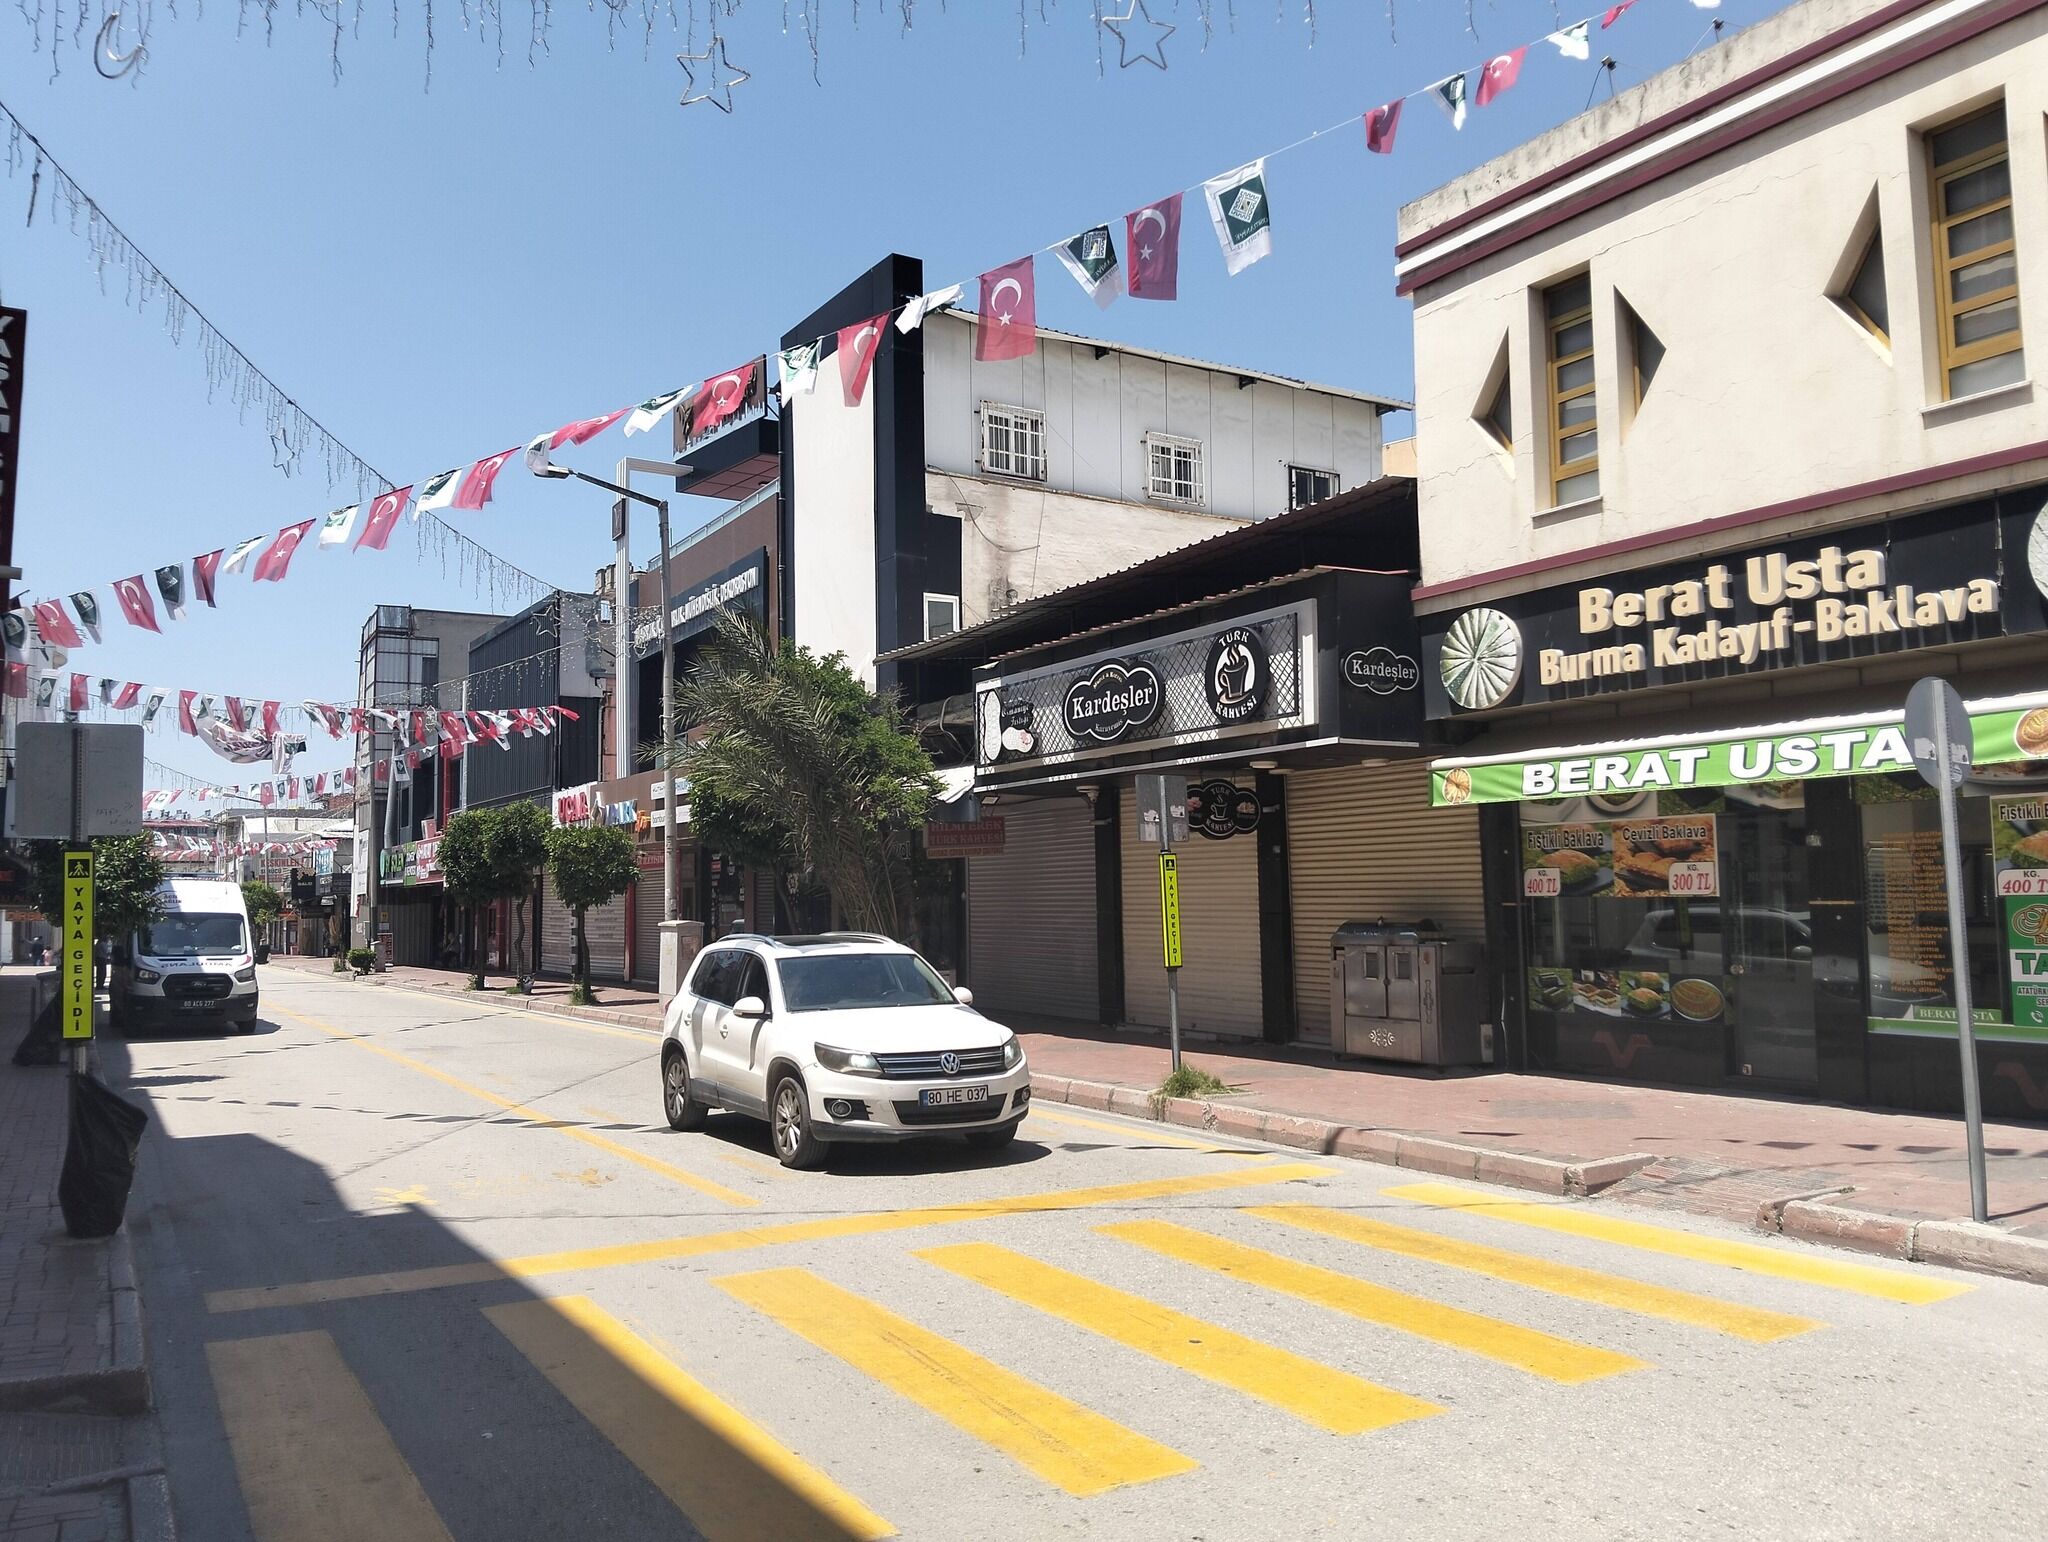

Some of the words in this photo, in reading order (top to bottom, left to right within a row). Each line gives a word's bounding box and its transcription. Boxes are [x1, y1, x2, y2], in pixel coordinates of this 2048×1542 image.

[1579, 565, 1734, 634] Berat
[1746, 546, 1886, 606] Usta
[1352, 659, 1415, 682] Kardeşler
[1540, 643, 1646, 686] Burma
[1072, 685, 1153, 719] Kardeşler
[1522, 747, 1708, 796] BERAT
[1729, 726, 1916, 780] USTA
[2000, 803, 2041, 820] Fıstıklı
[1563, 828, 1604, 848] Baklava
[1622, 825, 1659, 842] Cevizli
[1662, 825, 1707, 839] Baklava
[1672, 874, 1694, 890] 300
[1697, 872, 1712, 890] TL
[2023, 870, 2040, 878] KG.
[1168, 875, 1176, 907] YAYA
[1527, 879, 1545, 893] 400
[1548, 878, 1558, 893] TL
[2003, 880, 2032, 893] 400
[73, 887, 84, 940] YAYA
[72, 950, 84, 1031] GEÇİDİ
[1920, 1008, 1958, 1019] BERAT
[928, 1091, 942, 1104] 80
[946, 1089, 963, 1103] HE
[967, 1087, 987, 1101] 037
